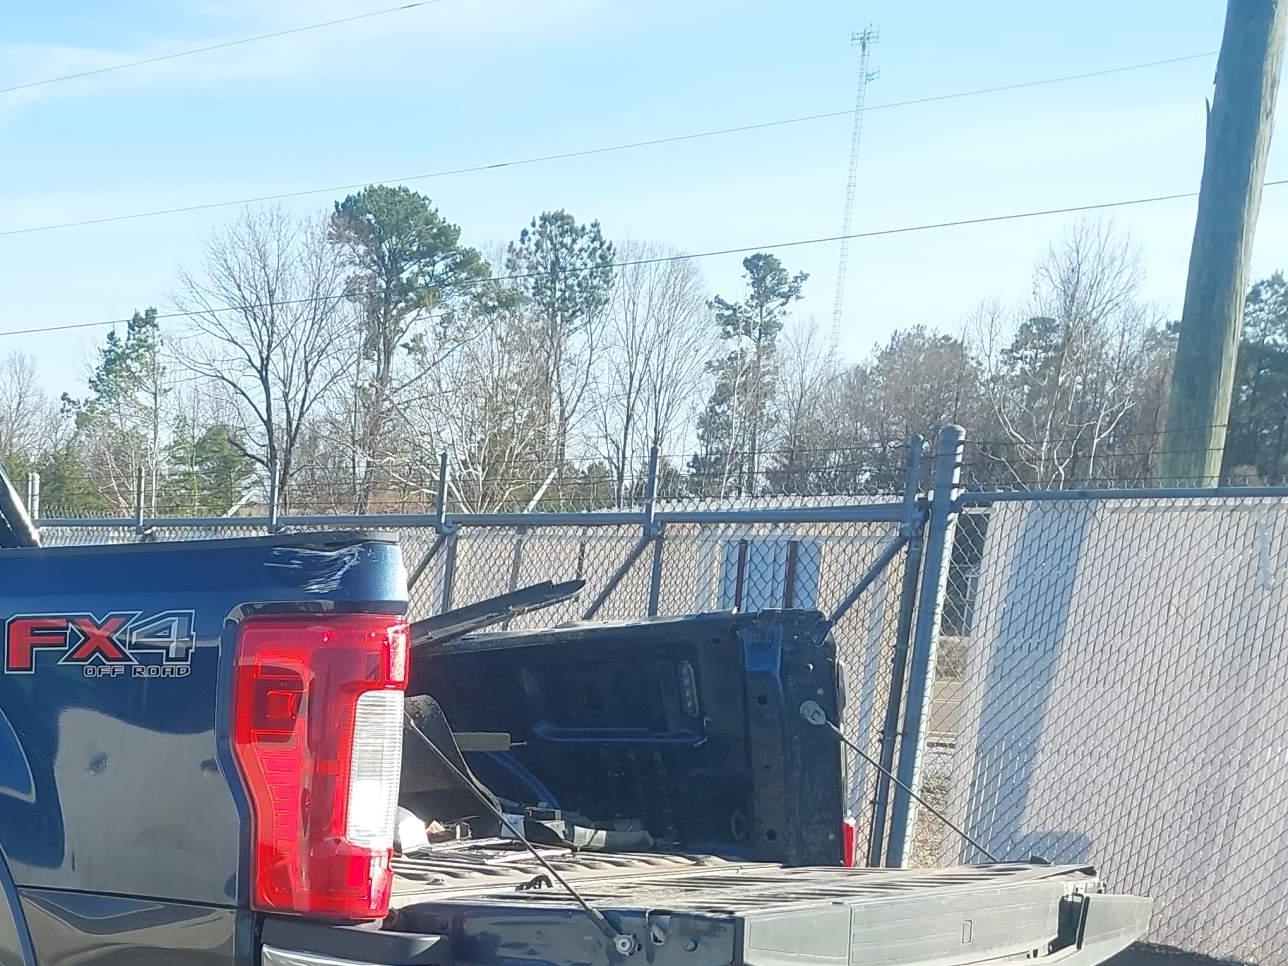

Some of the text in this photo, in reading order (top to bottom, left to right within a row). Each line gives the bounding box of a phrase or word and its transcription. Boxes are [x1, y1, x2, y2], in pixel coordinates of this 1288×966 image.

[5, 610, 196, 674] FX4
[83, 665, 191, 678] OFF ROAD
